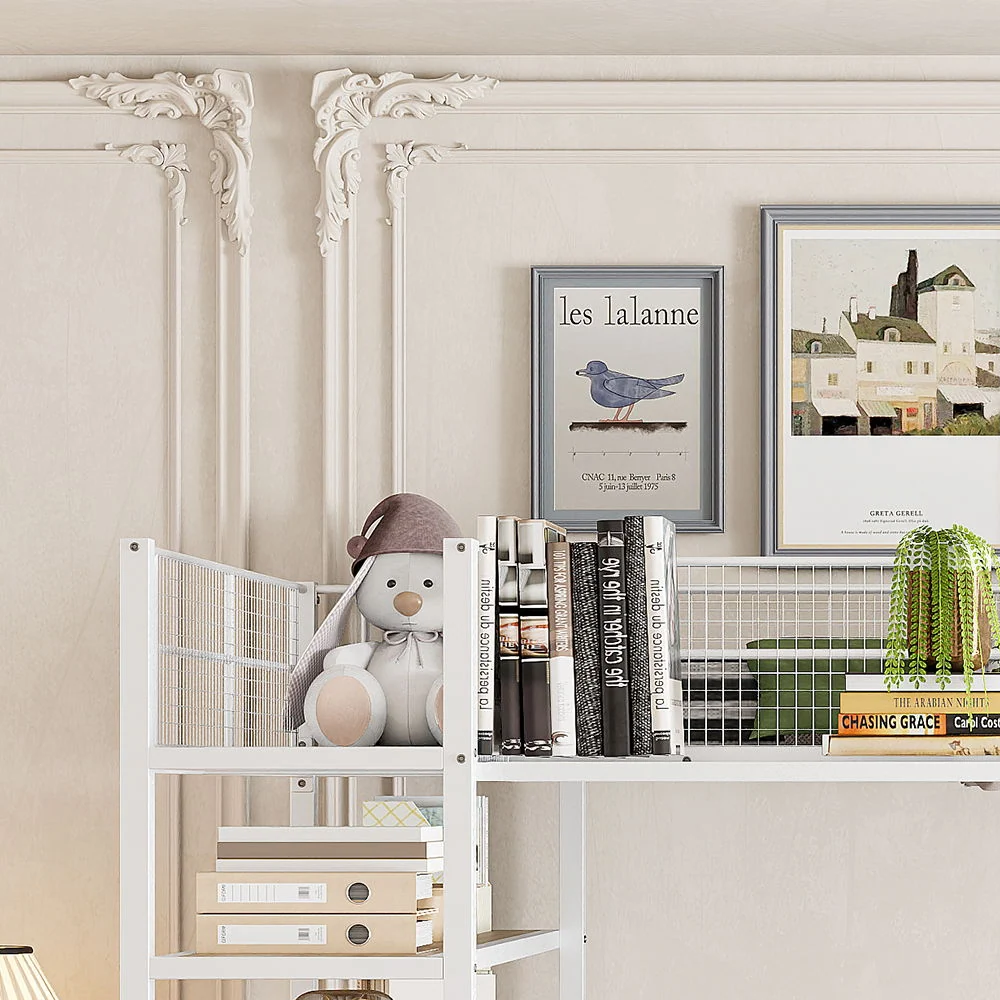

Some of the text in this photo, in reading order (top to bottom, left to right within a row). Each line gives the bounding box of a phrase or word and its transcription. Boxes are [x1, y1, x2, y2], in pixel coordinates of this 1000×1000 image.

[560, 296, 700, 326] les lalanne
[553, 550, 566, 560] 101
[554, 572, 567, 584] FOR
[555, 609, 568, 628] GRANT
[894, 698, 911, 708] THE
[914, 698, 953, 708] ARABIAN
[842, 715, 940, 729] CHASING GRACE
[954, 717, 978, 728] Carol
